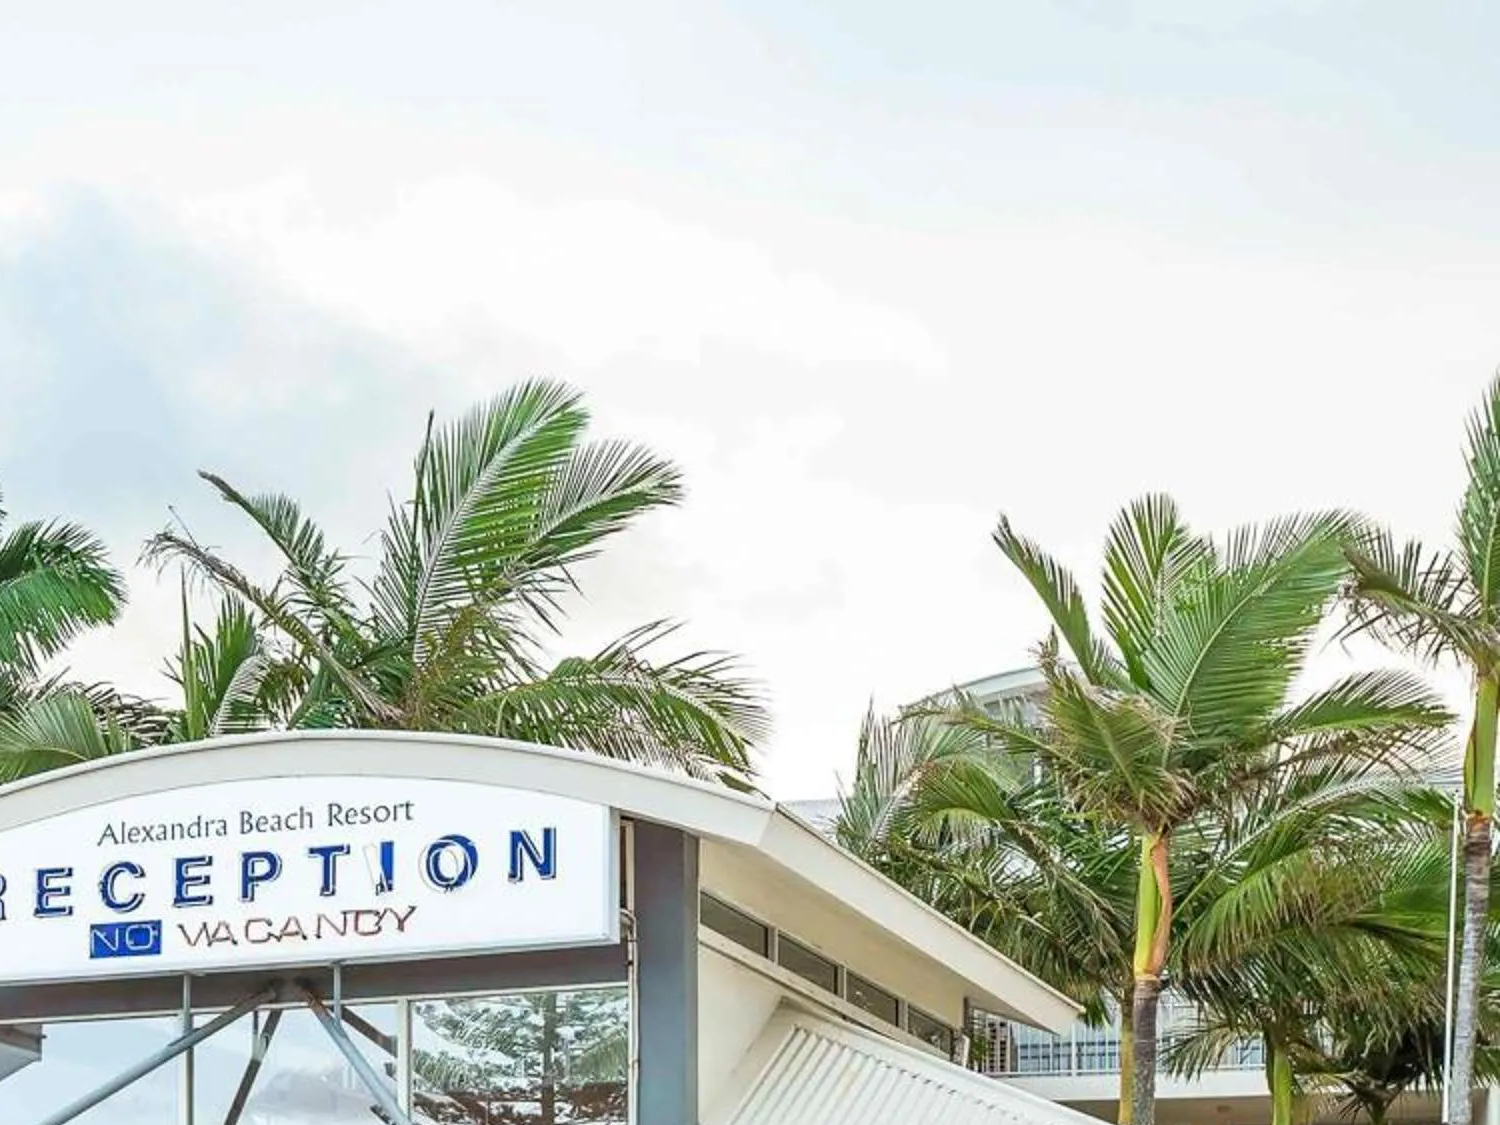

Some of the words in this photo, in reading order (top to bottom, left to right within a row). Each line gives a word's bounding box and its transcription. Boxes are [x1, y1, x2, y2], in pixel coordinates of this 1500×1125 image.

[97, 815, 228, 847] Alexandra
[239, 805, 314, 835] Beach
[327, 800, 415, 827] Resort
[91, 922, 159, 955] NO
